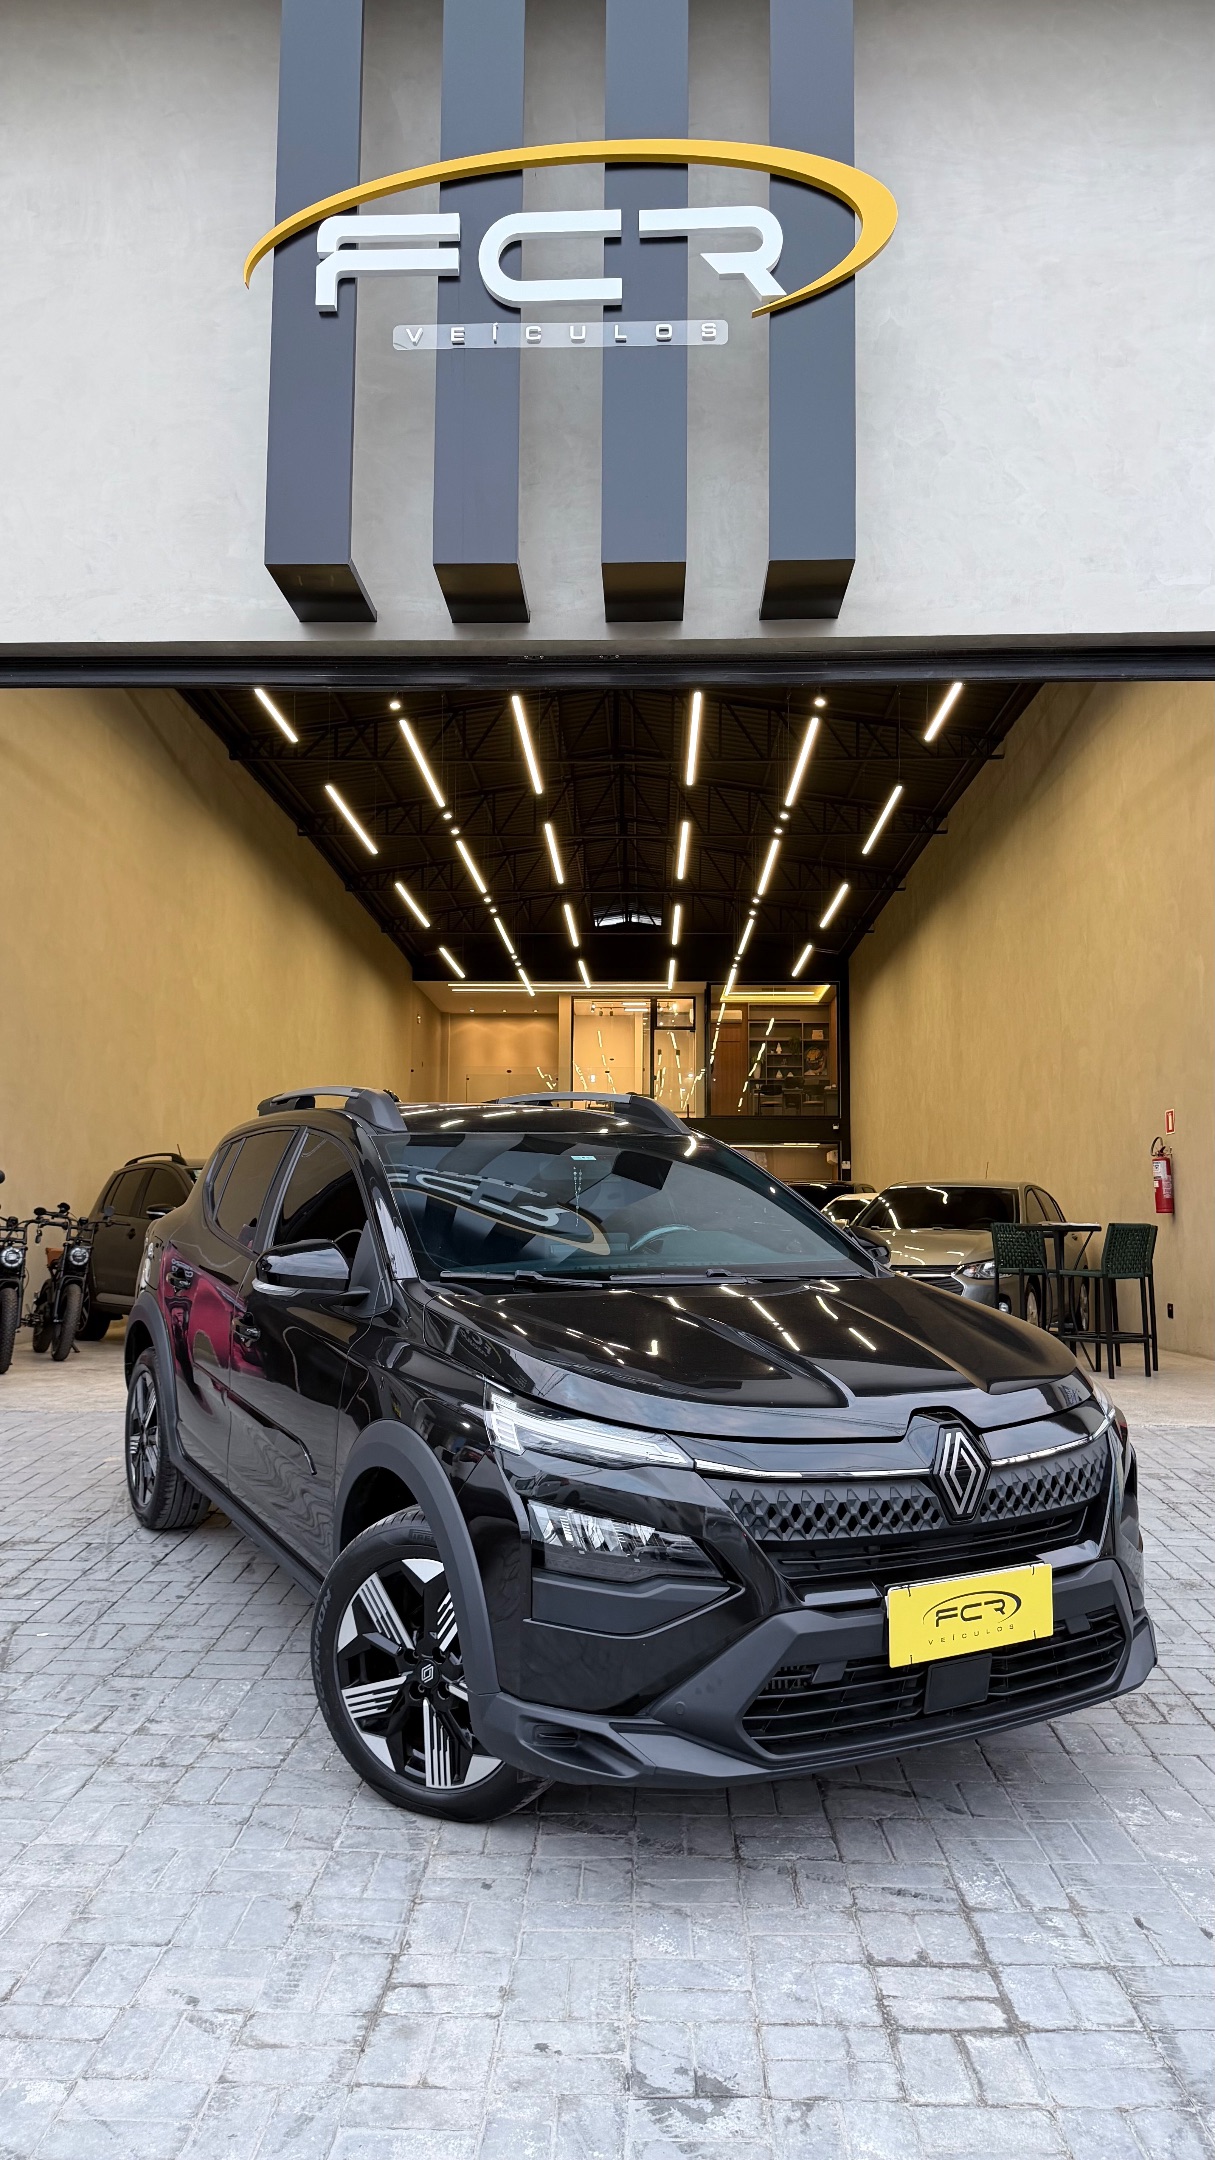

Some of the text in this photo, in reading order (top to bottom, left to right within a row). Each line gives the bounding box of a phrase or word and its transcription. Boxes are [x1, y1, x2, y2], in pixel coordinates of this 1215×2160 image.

[315, 205, 787, 312] FCR
[405, 322, 718, 347] VEÍCULOS
[935, 1598, 1006, 1628] FCR
